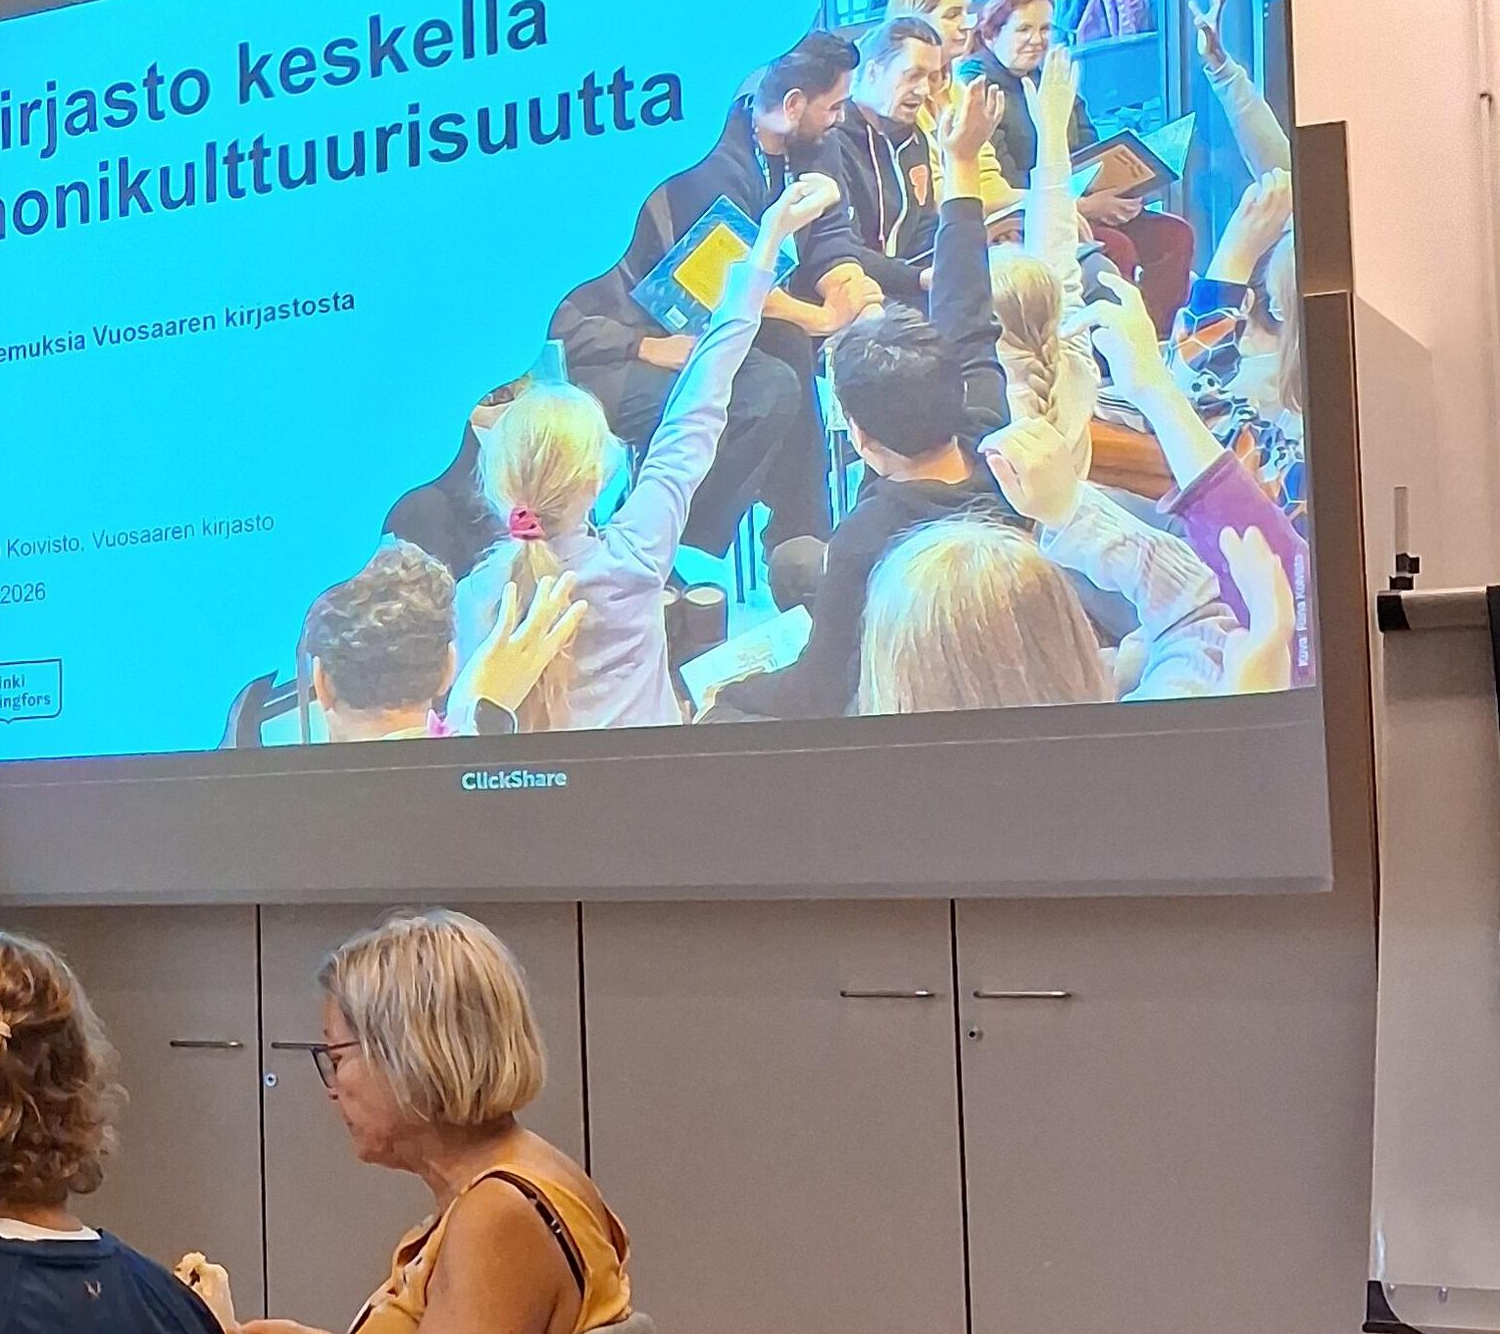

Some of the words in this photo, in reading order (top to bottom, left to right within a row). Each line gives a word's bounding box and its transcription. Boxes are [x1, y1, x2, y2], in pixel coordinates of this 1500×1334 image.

[93, 315, 217, 348] Vuosaaren
[226, 292, 356, 331] kirjastosta
[93, 525, 196, 550] Vuosaaren
[203, 515, 275, 540] kirjasto
[461, 770, 567, 790] ClickShare
